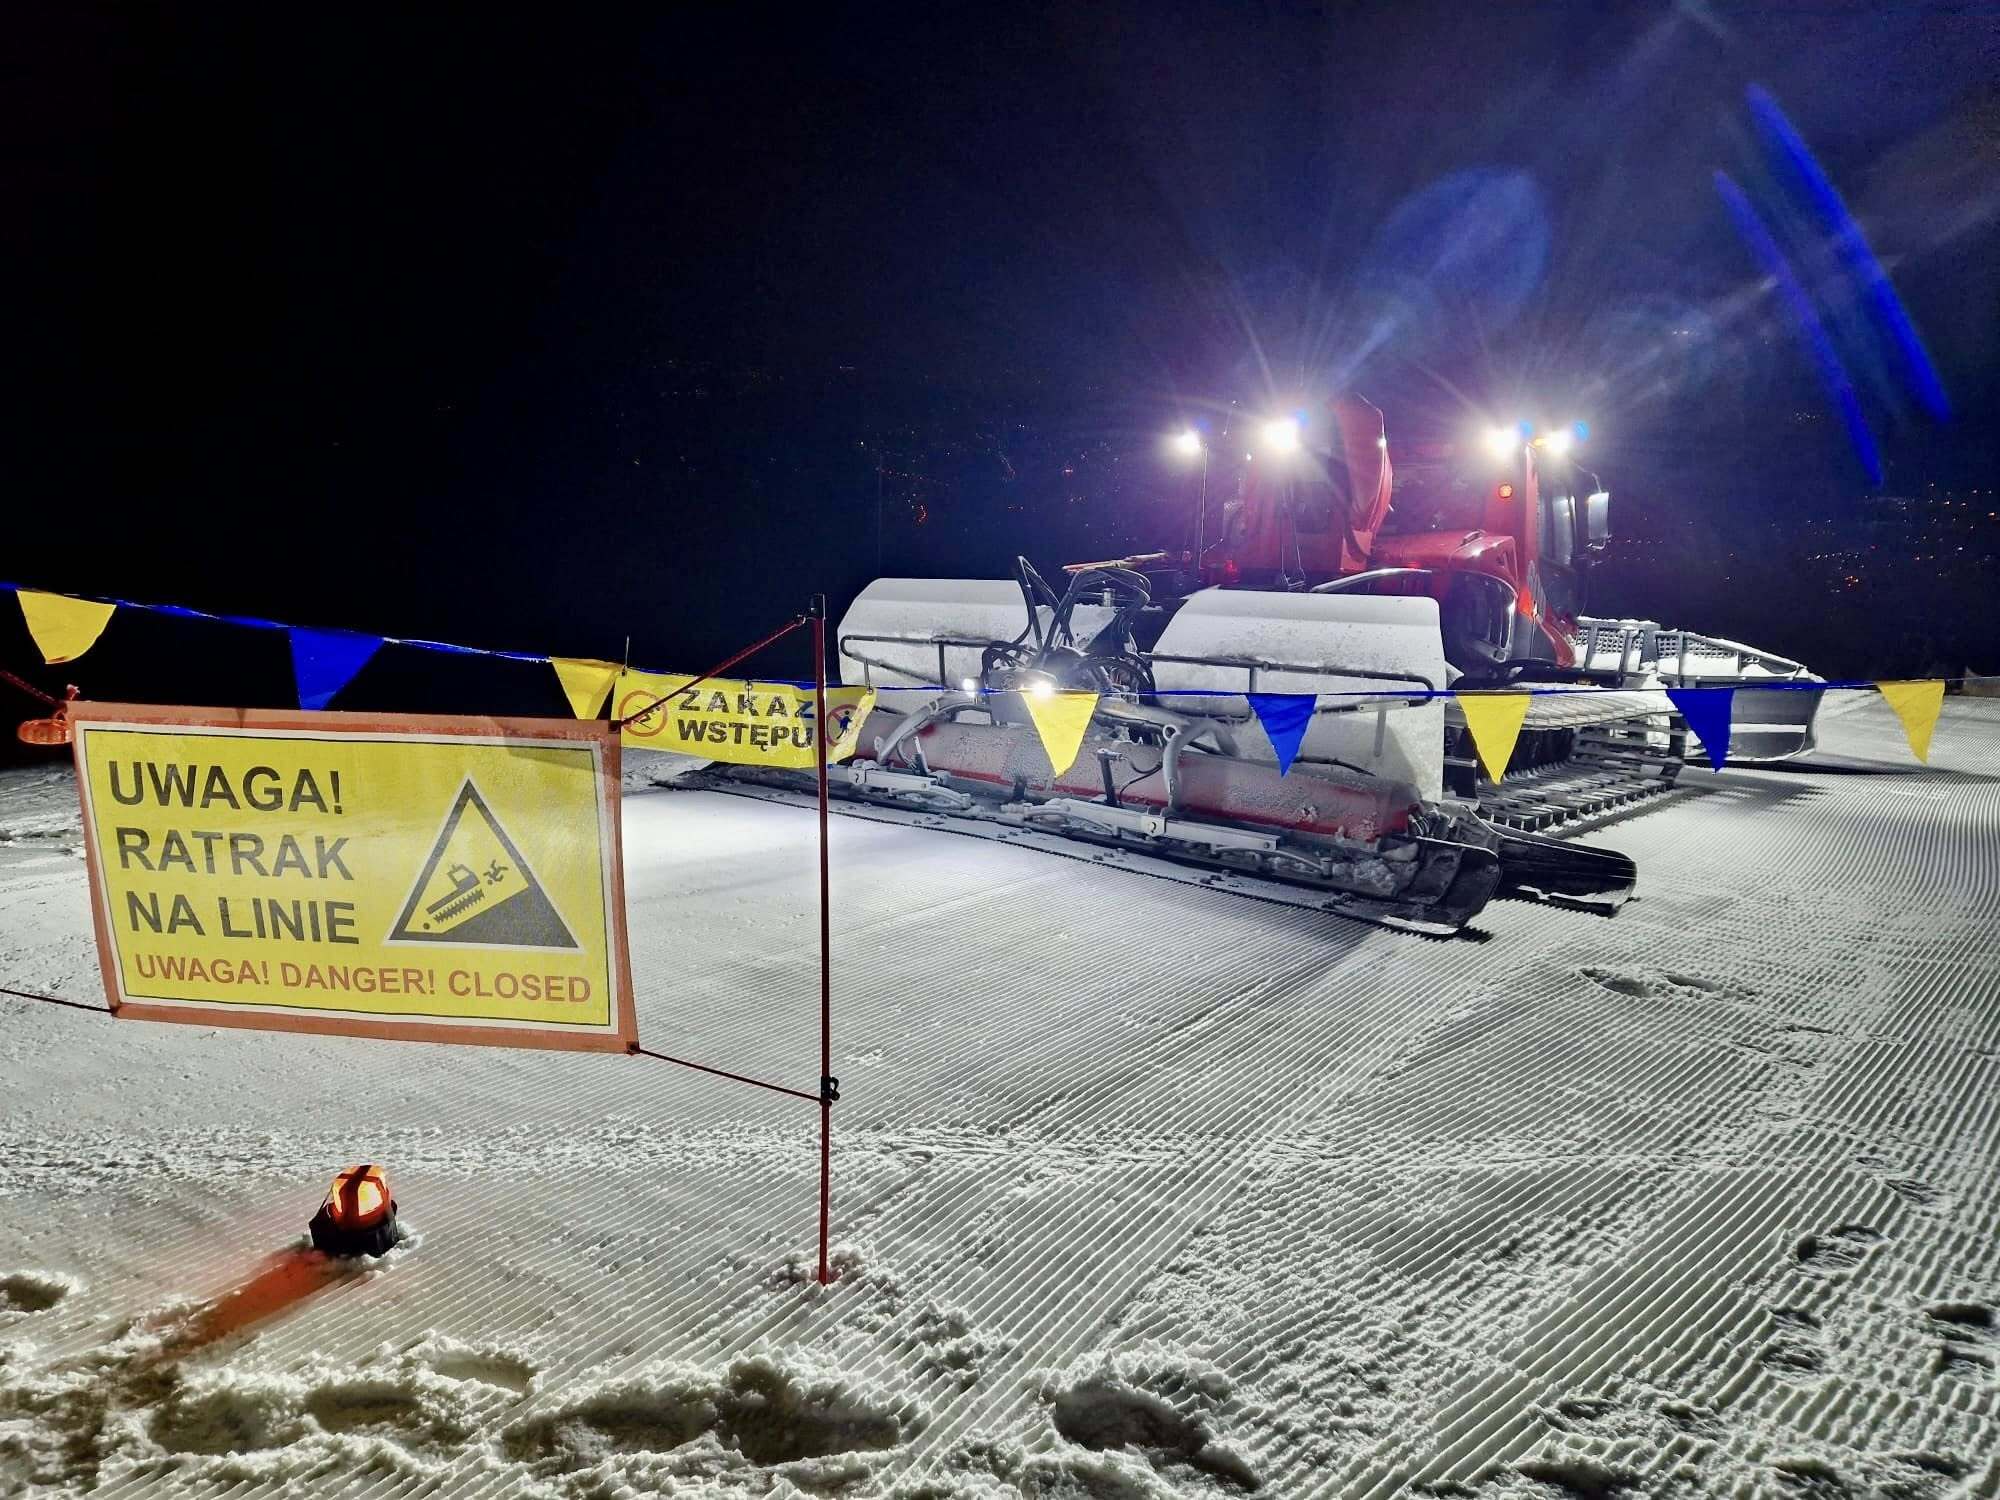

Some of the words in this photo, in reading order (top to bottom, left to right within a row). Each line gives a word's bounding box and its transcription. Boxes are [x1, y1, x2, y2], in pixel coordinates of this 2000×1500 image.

[678, 688, 815, 719] ZAKAZ
[677, 718, 814, 752] WSTĘPU
[108, 760, 344, 815] UWAGA!
[115, 826, 355, 882] RATRAK
[126, 889, 207, 937] NA
[218, 896, 360, 945] LINIE
[135, 953, 269, 987] UWAGA!
[281, 961, 437, 996] DANGER!
[448, 969, 592, 1003] CLOSED
